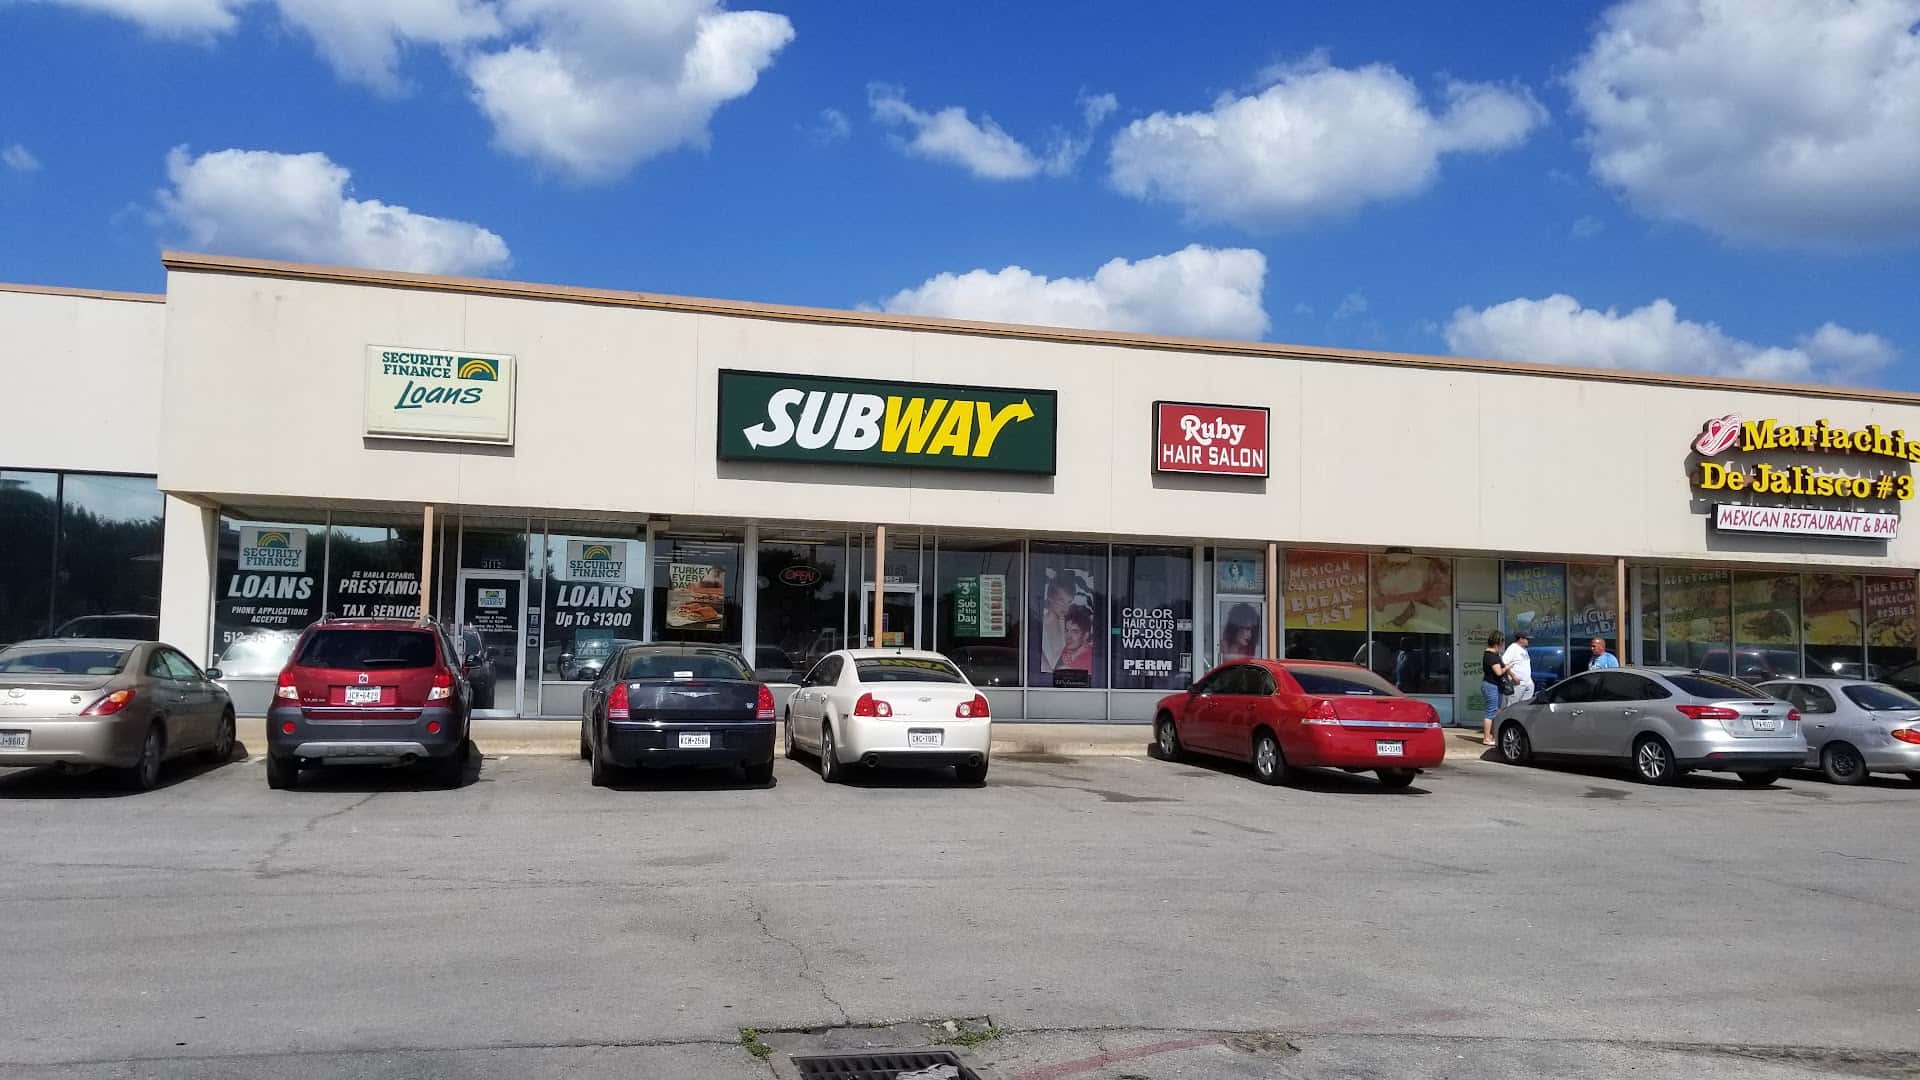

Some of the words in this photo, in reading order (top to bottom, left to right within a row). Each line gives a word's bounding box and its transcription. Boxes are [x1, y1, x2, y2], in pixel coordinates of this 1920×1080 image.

[382, 351, 454, 368] SECURITY
[383, 363, 452, 379] FINANCE
[394, 380, 484, 410] Loans
[743, 388, 1034, 457] SUBWAY
[1180, 414, 1246, 446] Ruby
[1742, 419, 1920, 462] Mariachis
[1163, 444, 1202, 465] HAIR
[1208, 447, 1263, 468] SALON
[1700, 462, 1745, 490] De
[1753, 463, 1871, 499] Jalisco
[1719, 509, 1780, 529] MEXICAN
[1782, 511, 1862, 533] RESTAURANT
[1863, 519, 1872, 533] &
[1873, 517, 1898, 534] BAR
[243, 547, 303, 558] SECURITY
[246, 556, 299, 568] FINANCE
[569, 560, 623, 570] SECURITY
[572, 568, 621, 578] FINANCE
[671, 565, 712, 575] TURKEY
[1289, 560, 1351, 577] MEXICAN
[672, 573, 705, 582] EVERY
[785, 570, 816, 580] OPEN
[227, 574, 314, 600] LOANS
[672, 581, 690, 590] DAY
[556, 585, 634, 608] LOANS
[957, 599, 977, 608] Sub
[231, 606, 256, 615] PHONE
[257, 607, 309, 616] APPLICATIONS
[342, 604, 367, 617] TAX
[1122, 607, 1173, 619] COLOR
[250, 615, 288, 624] ACCEPTED
[555, 611, 574, 628] Up
[575, 611, 591, 626] To
[592, 612, 632, 627] $1300
[957, 613, 977, 625] Day
[1123, 618, 1146, 629] HAIR
[1148, 619, 1175, 630] CUTS
[1122, 628, 1173, 639] UP-DOS
[1122, 638, 1174, 649] WAXING
[1123, 659, 1173, 671] PERM
